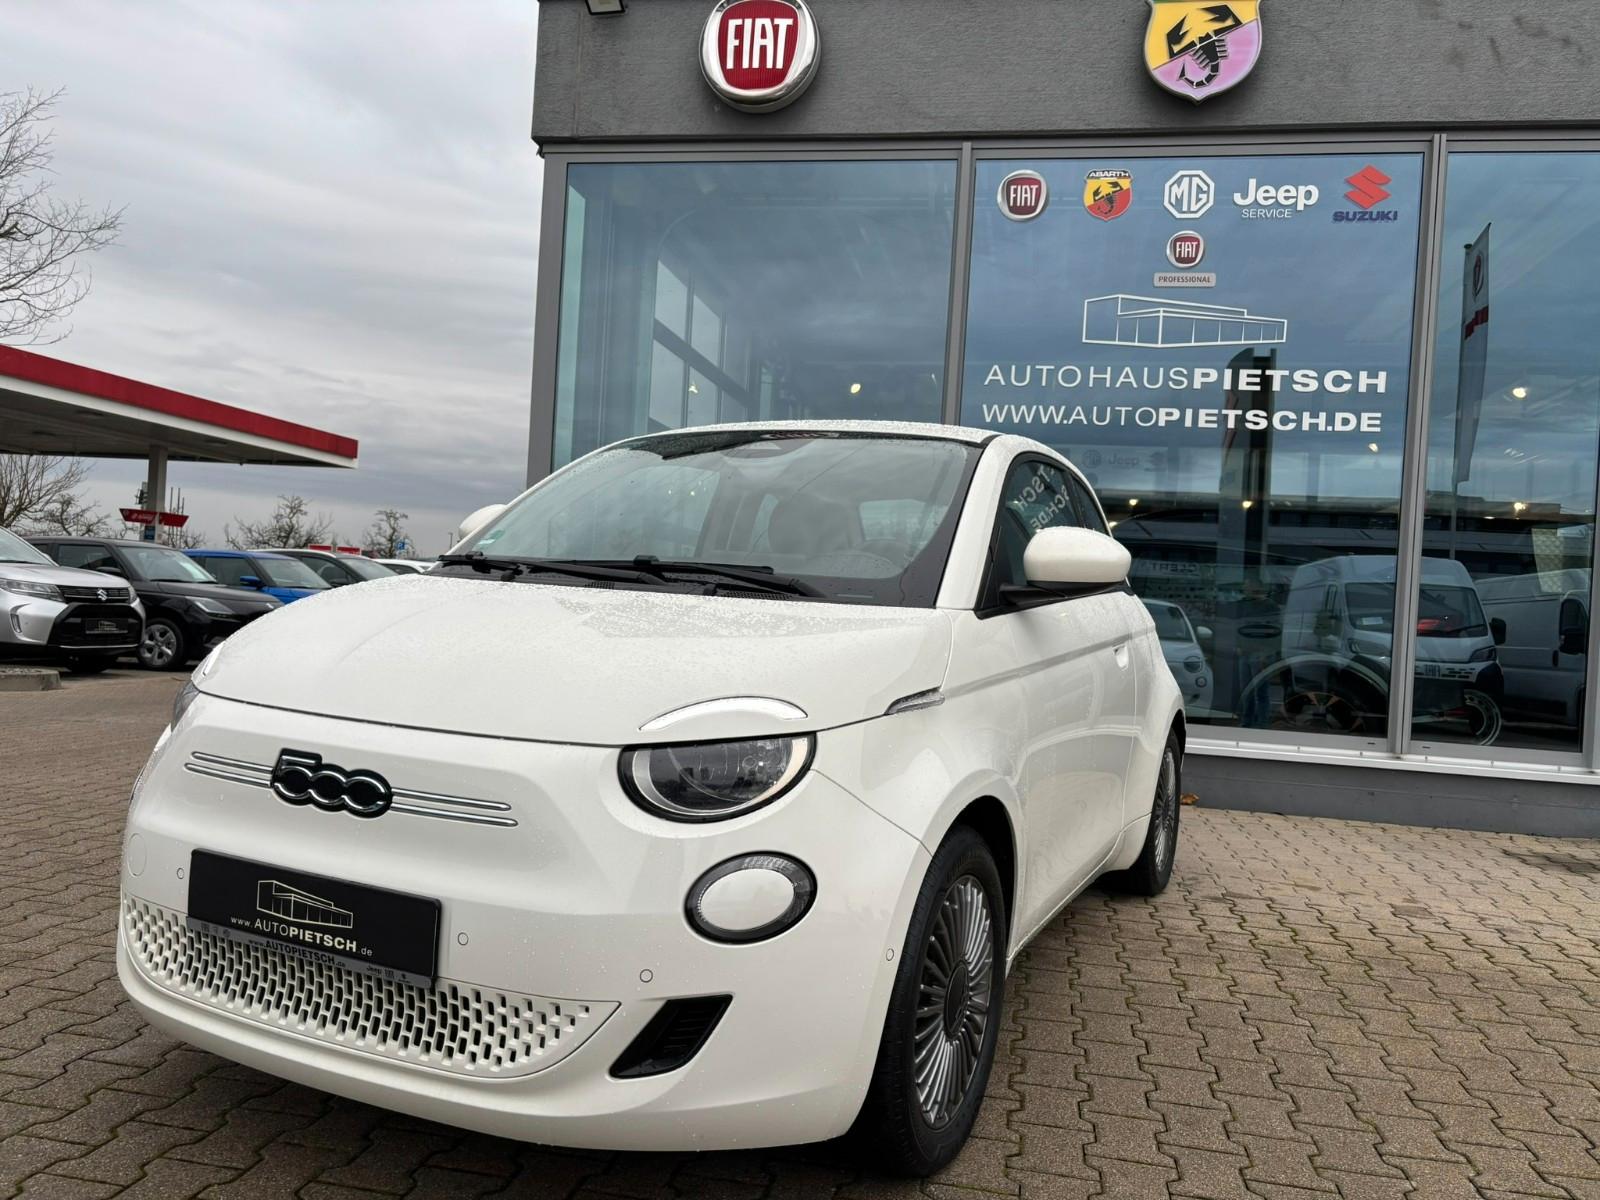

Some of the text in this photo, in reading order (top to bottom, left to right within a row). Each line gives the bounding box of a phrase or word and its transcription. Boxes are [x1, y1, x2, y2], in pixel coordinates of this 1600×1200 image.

[726, 18, 793, 69] FIAT
[1010, 184, 1038, 207] FIAT
[1169, 176, 1209, 213] MG
[1233, 178, 1319, 211] Jeep
[1241, 208, 1293, 219] SERVICE
[1333, 210, 1398, 222] SUZUKI
[1176, 241, 1199, 258] FIAT
[1158, 274, 1211, 284] PROFESSIONAL
[982, 403, 1382, 433] WWW.AUTOPIETSCH.DE
[271, 749, 392, 818] 500
